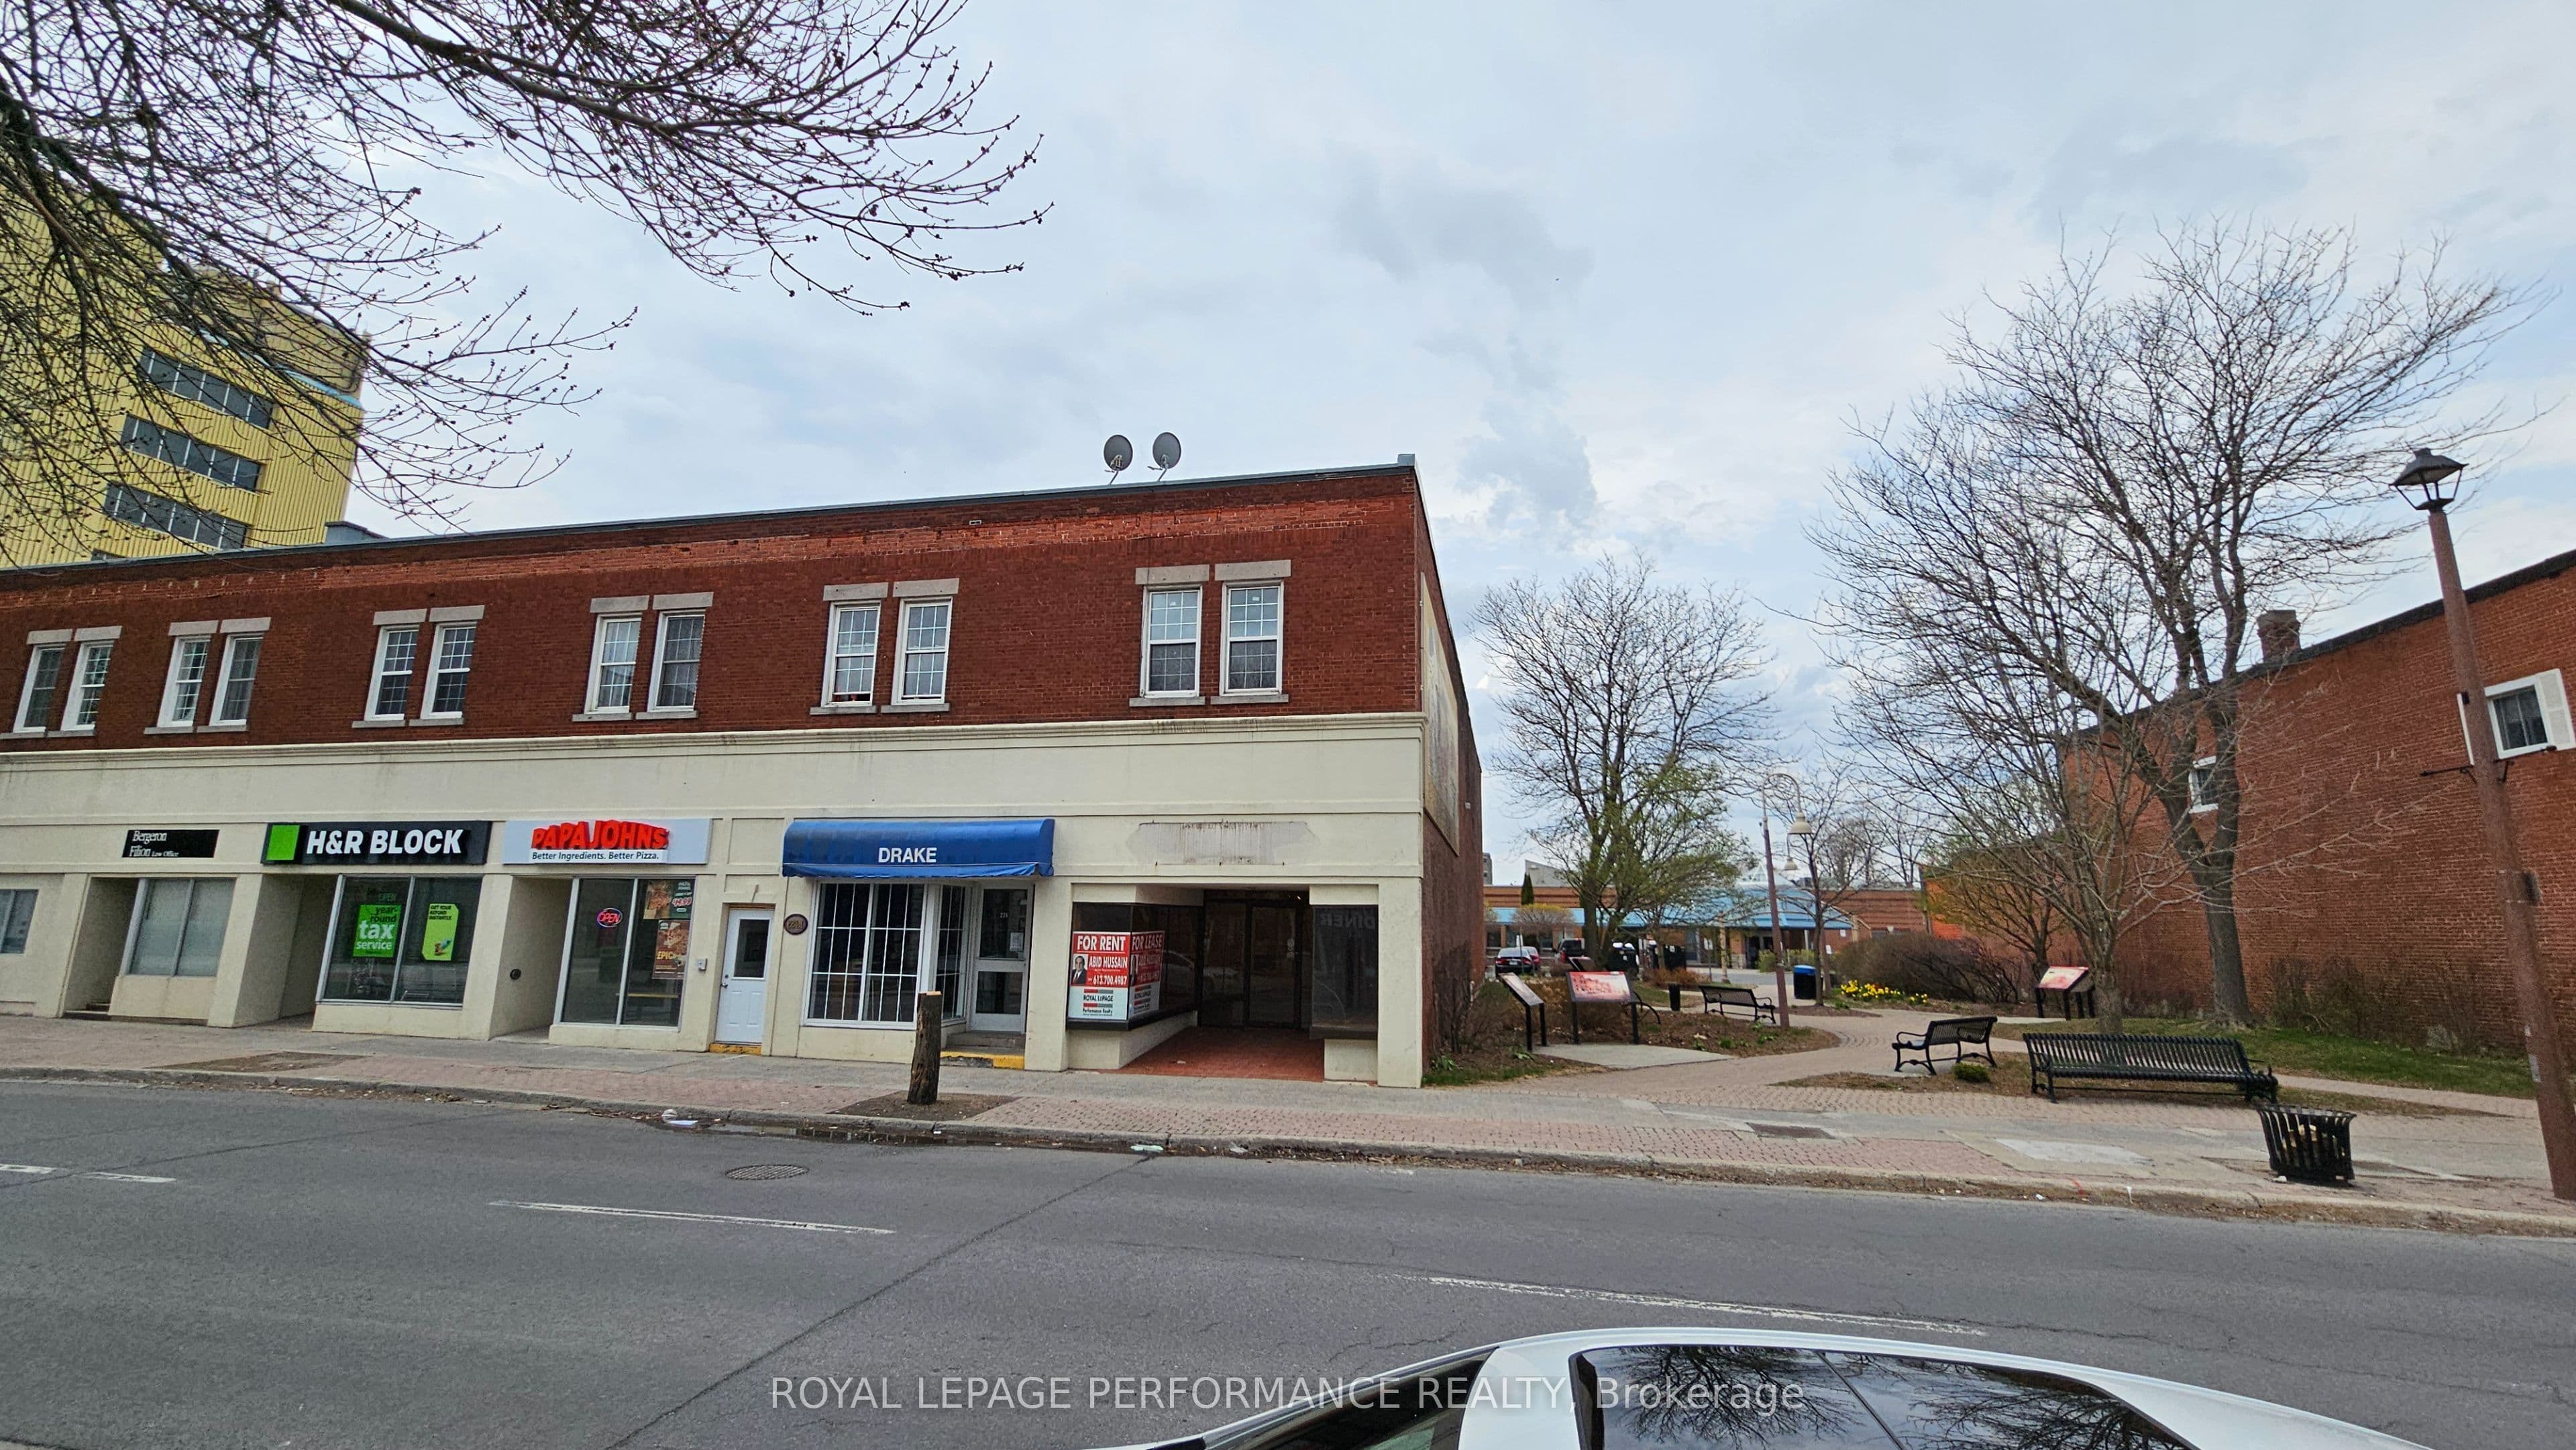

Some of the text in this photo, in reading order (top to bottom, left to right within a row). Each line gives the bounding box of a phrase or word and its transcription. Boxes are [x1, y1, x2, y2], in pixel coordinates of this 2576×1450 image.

[132, 830, 167, 845] Bergeron
[531, 819, 669, 849] PAPA JOHNS
[306, 829, 464, 855] H&R BLOCK
[129, 845, 151, 857] Filion
[532, 851, 659, 862] Better Ingredients. Better Pizza.
[878, 847, 937, 863] DRAKE
[370, 914, 397, 923] round
[599, 913, 620, 923] OPEN
[359, 920, 394, 939] tax
[356, 939, 392, 950] service
[1077, 935, 1126, 951] FOR RENT
[1132, 934, 1163, 951] FOR LEASE
[657, 951, 674, 960] EPIC
[1088, 955, 1128, 969] ABID HUSSAIN
[1093, 974, 1127, 985] 613.700.4987
